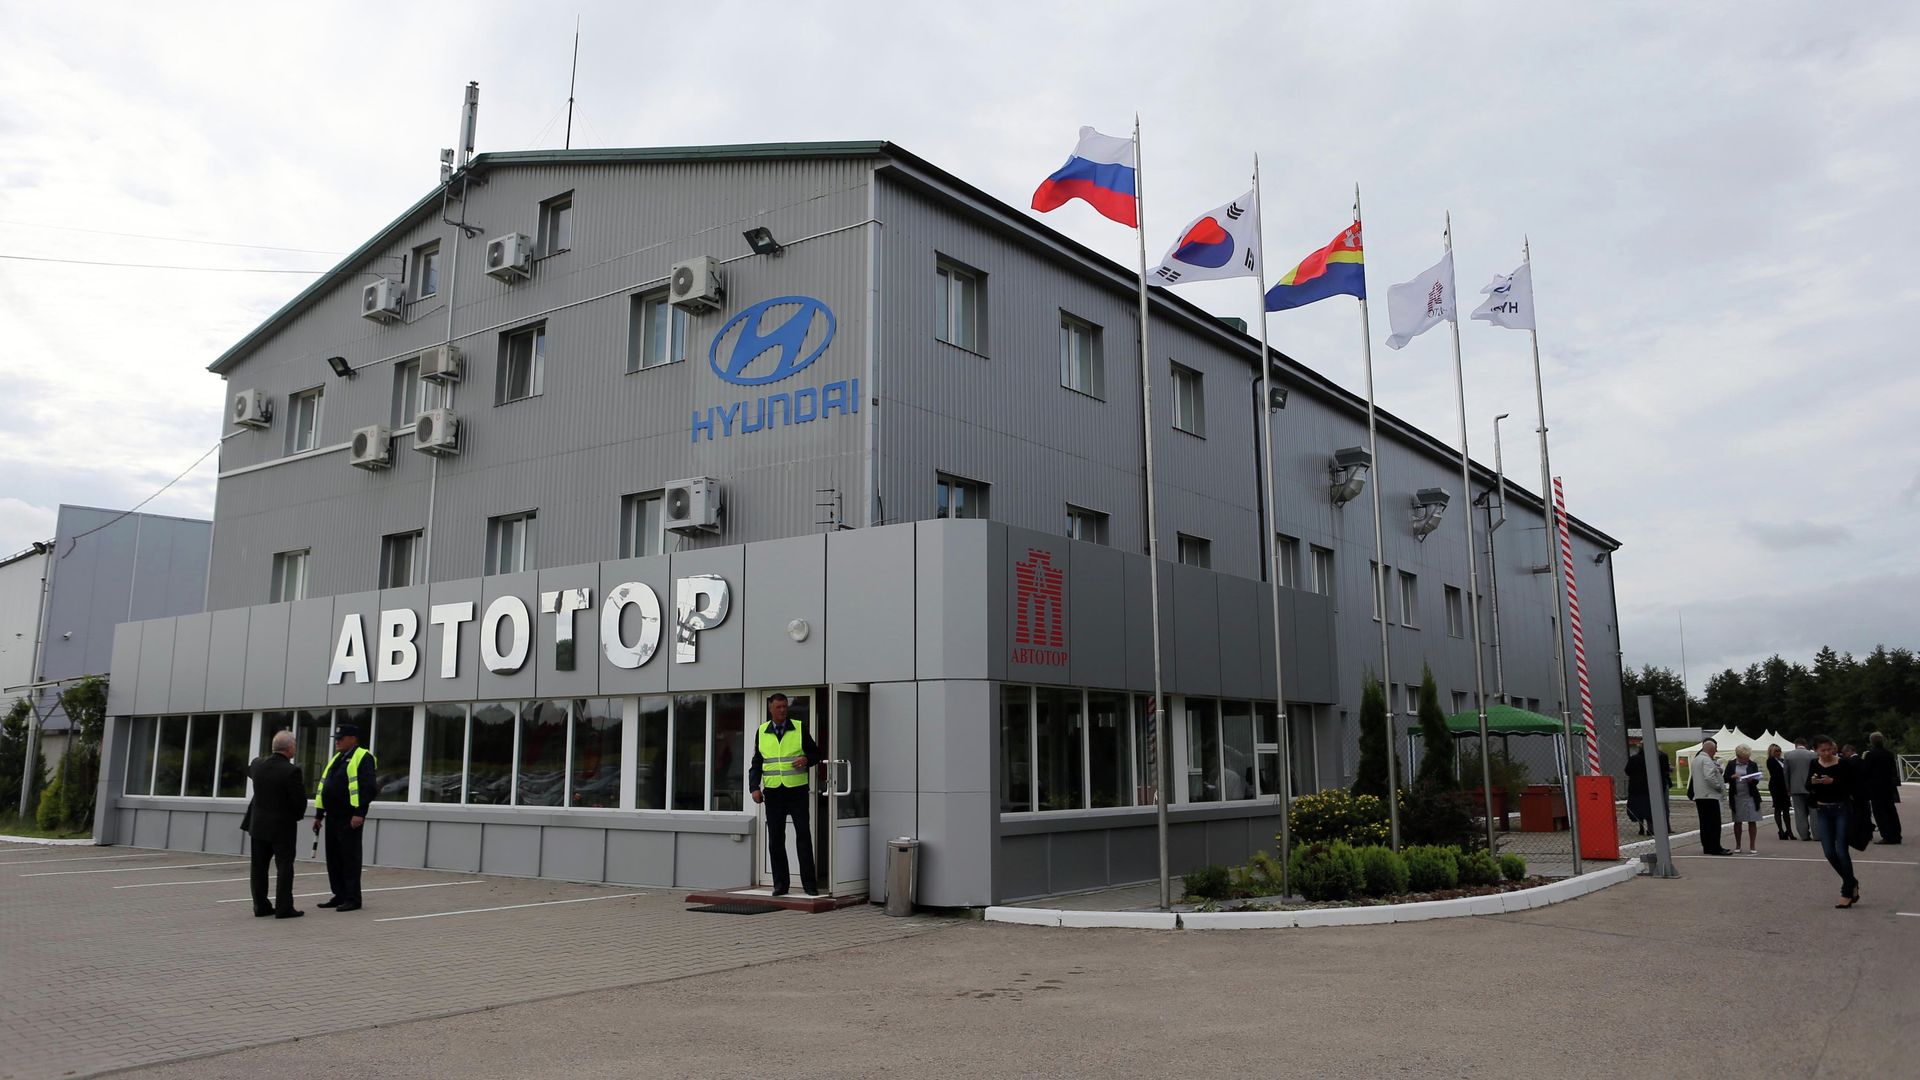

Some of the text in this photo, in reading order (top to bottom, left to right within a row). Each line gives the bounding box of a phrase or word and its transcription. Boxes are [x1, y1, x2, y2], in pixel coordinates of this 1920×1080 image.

[691, 378, 859, 443] HYUNDAI
[327, 573, 730, 685] АВТОТОР
[1011, 647, 1068, 666] АВТОТОР
